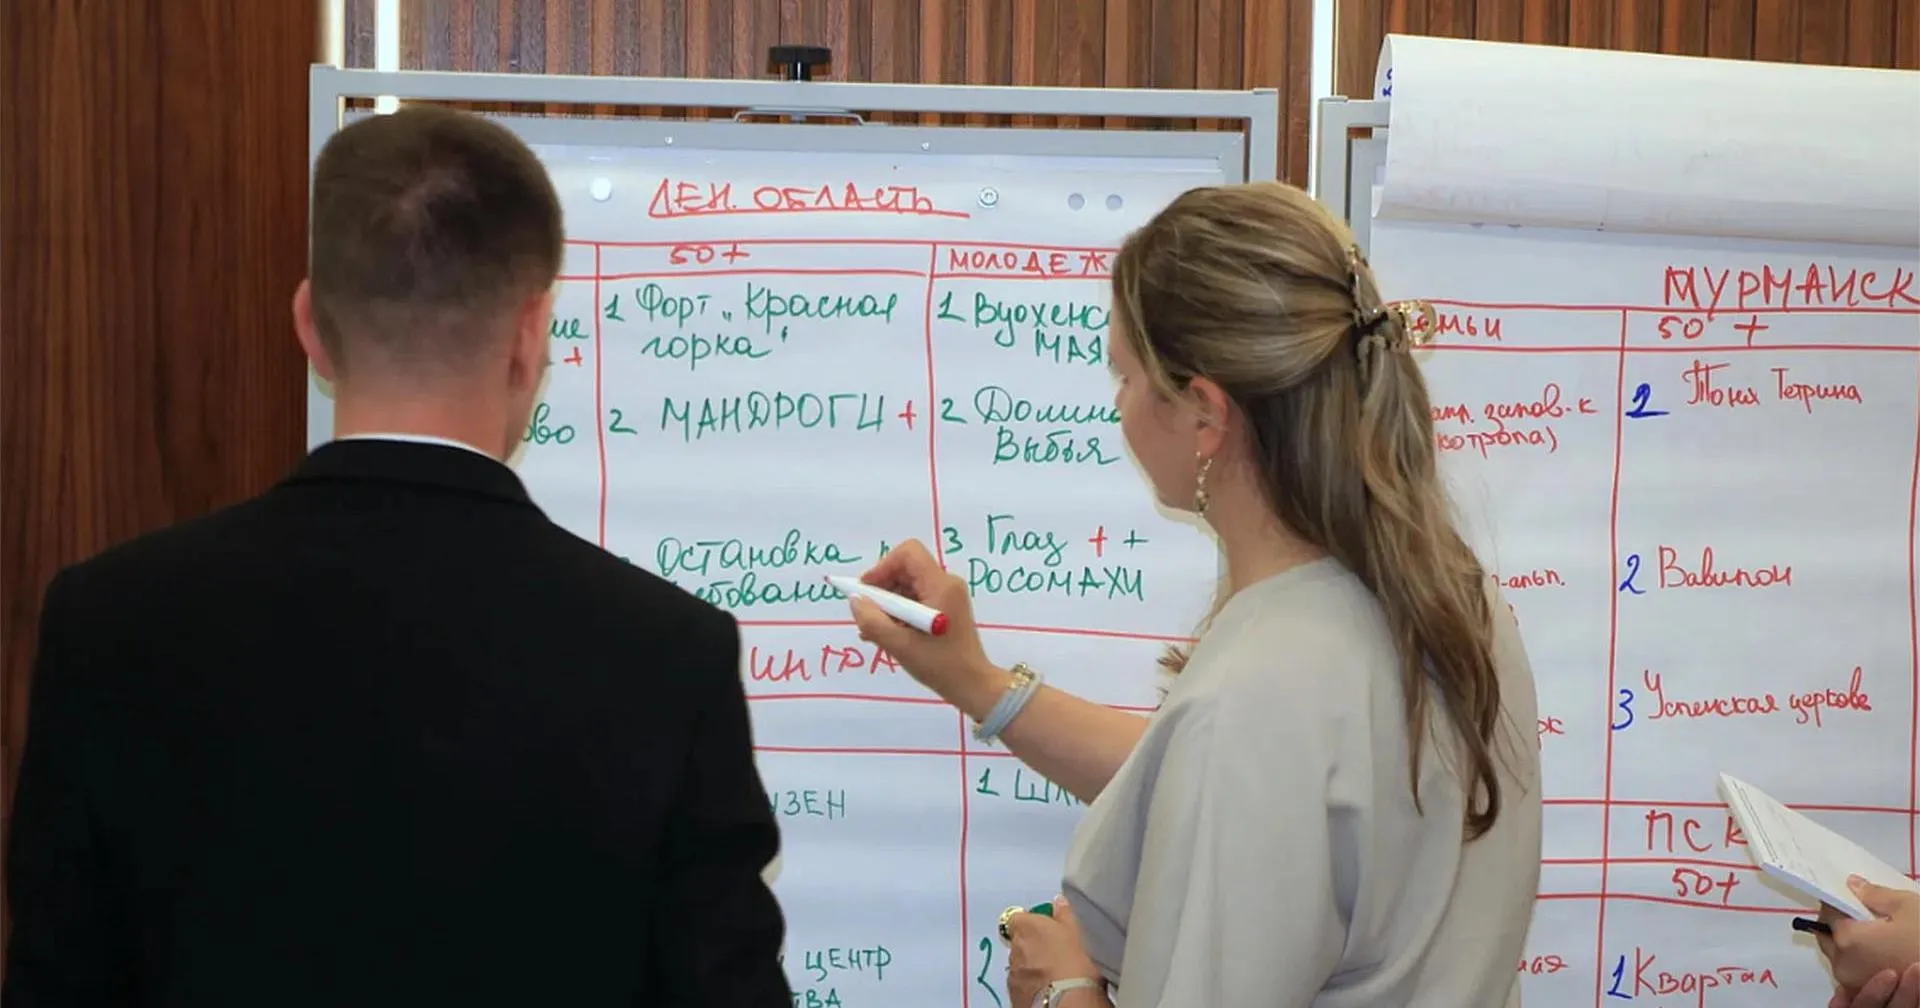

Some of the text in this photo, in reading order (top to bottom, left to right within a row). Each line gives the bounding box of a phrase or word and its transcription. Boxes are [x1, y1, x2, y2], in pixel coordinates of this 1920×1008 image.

[753, 181, 933, 214] ОБЛАСТЬ
[669, 242, 750, 265] 50+
[950, 248, 1110, 277] МОЛОДЕЖ
[604, 294, 626, 322] 1
[636, 282, 712, 329] Форт
[937, 291, 1111, 348] 1 Вуохенс
[1034, 328, 1112, 367] МАЯ
[608, 408, 638, 435] 2
[941, 398, 968, 425] 2
[1434, 425, 1558, 460] котропа)
[656, 528, 862, 578] Остановка
[942, 527, 964, 554] 3
[986, 514, 1068, 567] Глаз
[967, 558, 1144, 602] РОСОМАХИ
[1618, 554, 1647, 595] 2
[749, 644, 898, 683] ИНГРА
[1611, 688, 1634, 731] 3
[976, 768, 999, 796] 1
[1645, 808, 1749, 853] ПСК
[1671, 867, 1741, 906] 50+
[804, 945, 892, 982] ЦЕНТР
[1606, 946, 1779, 1000] 1 Квартал
